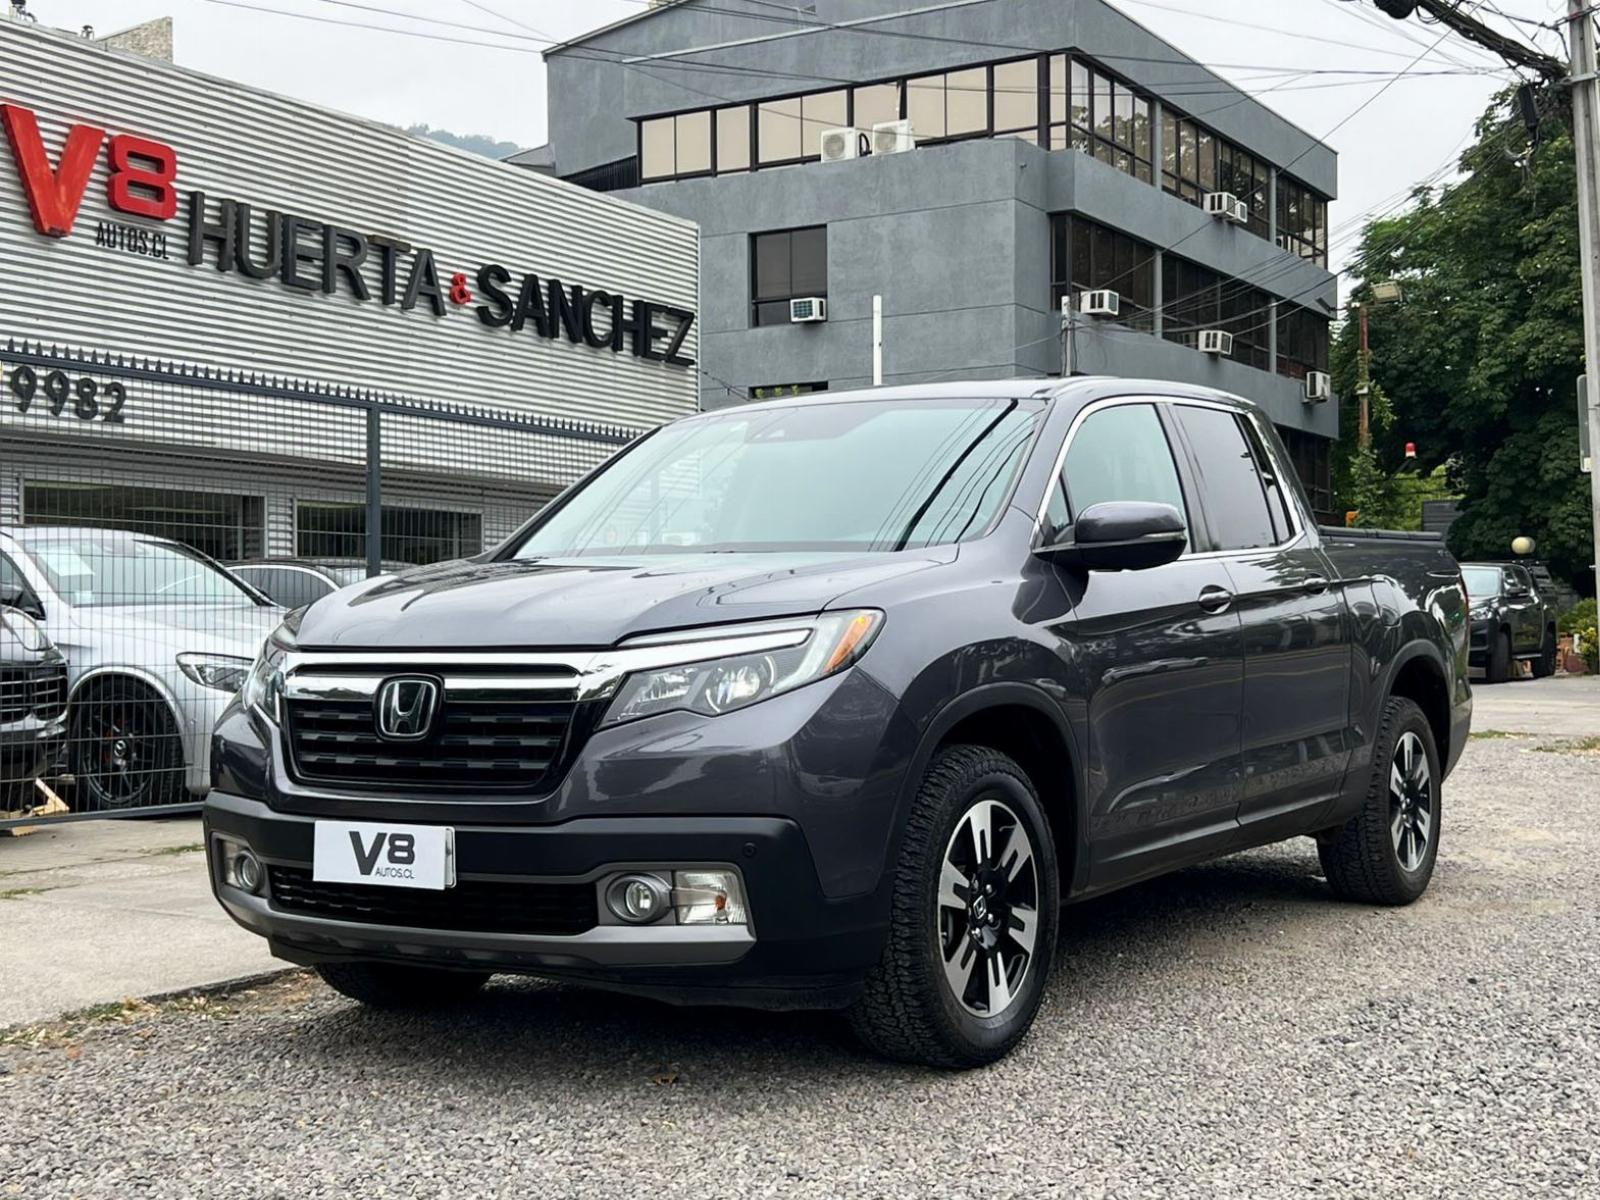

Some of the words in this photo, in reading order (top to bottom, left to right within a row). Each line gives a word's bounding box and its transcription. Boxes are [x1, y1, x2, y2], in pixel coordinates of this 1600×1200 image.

[1, 103, 177, 239] V8
[96, 221, 169, 260] AUTOS.CL
[187, 190, 447, 317] HUERTA
[450, 272, 472, 306] &
[476, 263, 696, 368] SANCHEZ
[10, 365, 127, 424] 9982
[348, 830, 416, 876] V8
[375, 867, 415, 880] AUTOS.CL
